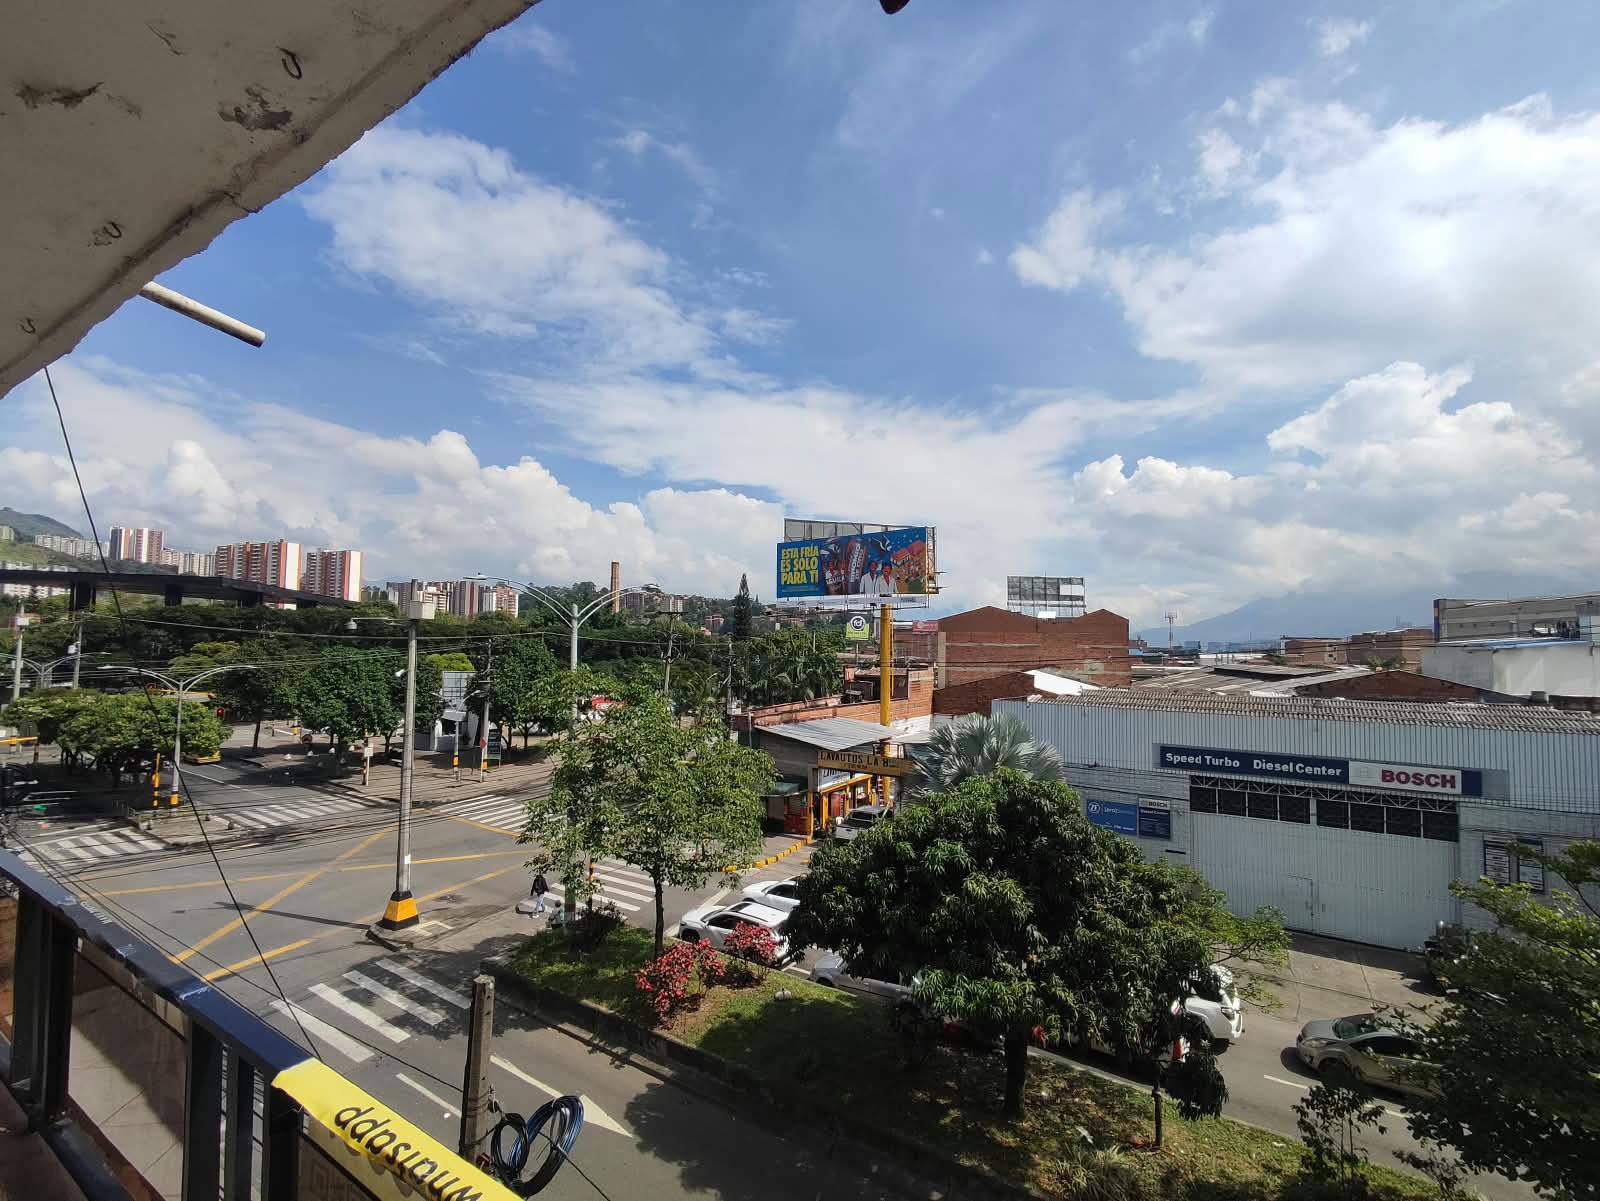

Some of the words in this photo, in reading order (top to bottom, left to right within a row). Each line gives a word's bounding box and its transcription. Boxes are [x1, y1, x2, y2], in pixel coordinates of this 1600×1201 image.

[782, 548, 799, 559] ESTA
[801, 544, 819, 557] FRÍA
[781, 559, 791, 572] ES
[793, 557, 818, 571] SOLO
[781, 571, 807, 585] PARA
[810, 569, 819, 584] TI
[1166, 753, 1201, 764] Speed
[1204, 755, 1240, 767] Turbo
[1253, 759, 1293, 772] Diesel
[1296, 763, 1342, 777] Center
[1381, 769, 1456, 789] BOSCH
